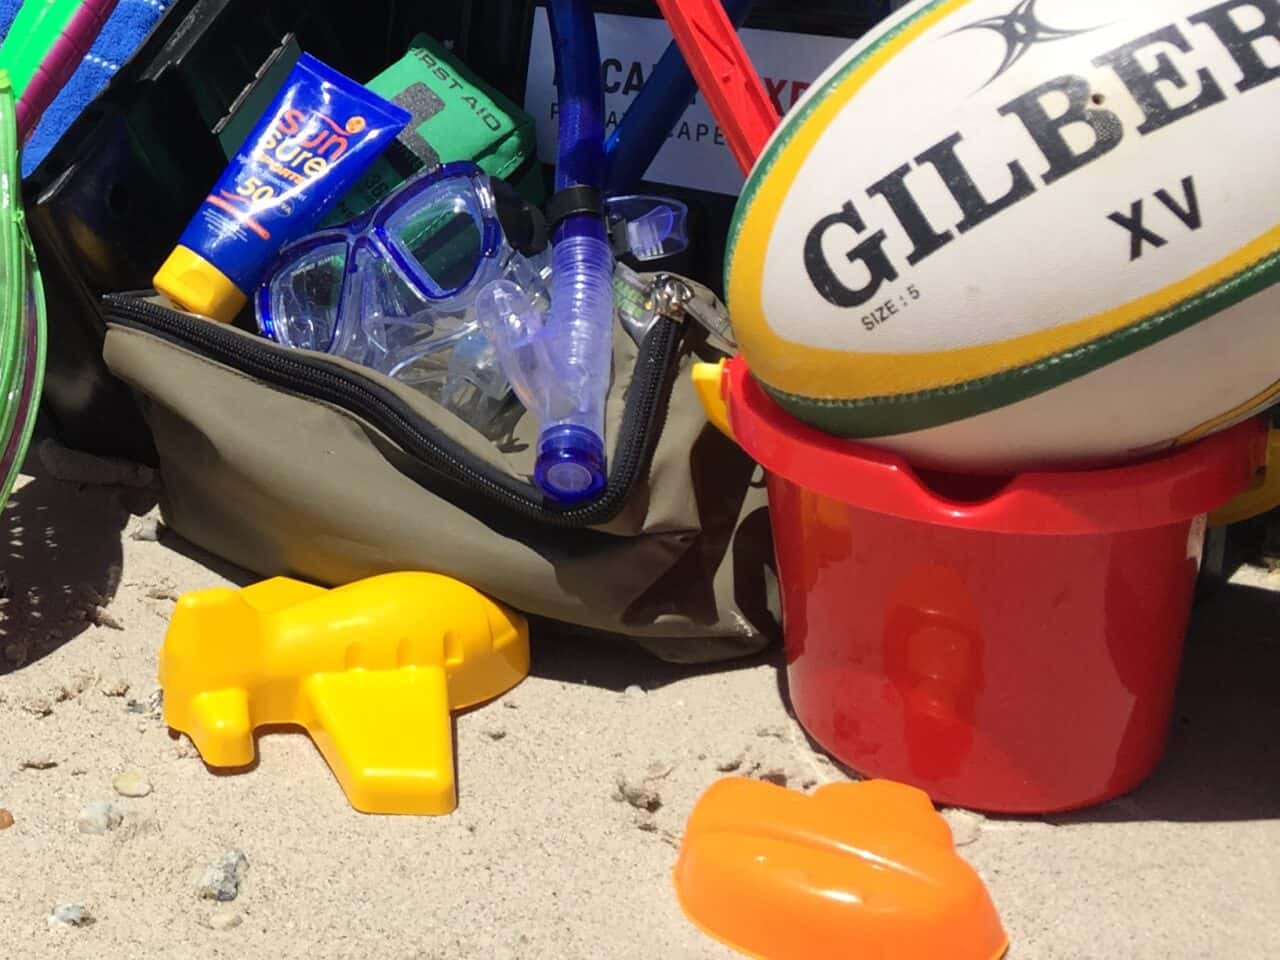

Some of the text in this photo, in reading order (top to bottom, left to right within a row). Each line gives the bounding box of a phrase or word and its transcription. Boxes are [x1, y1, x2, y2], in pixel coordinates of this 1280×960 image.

[410, 47, 464, 91] IRST
[461, 95, 503, 132] AID
[1106, 175, 1203, 262] XV
[860, 298, 900, 332] SIZE
[906, 283, 921, 300] 5
